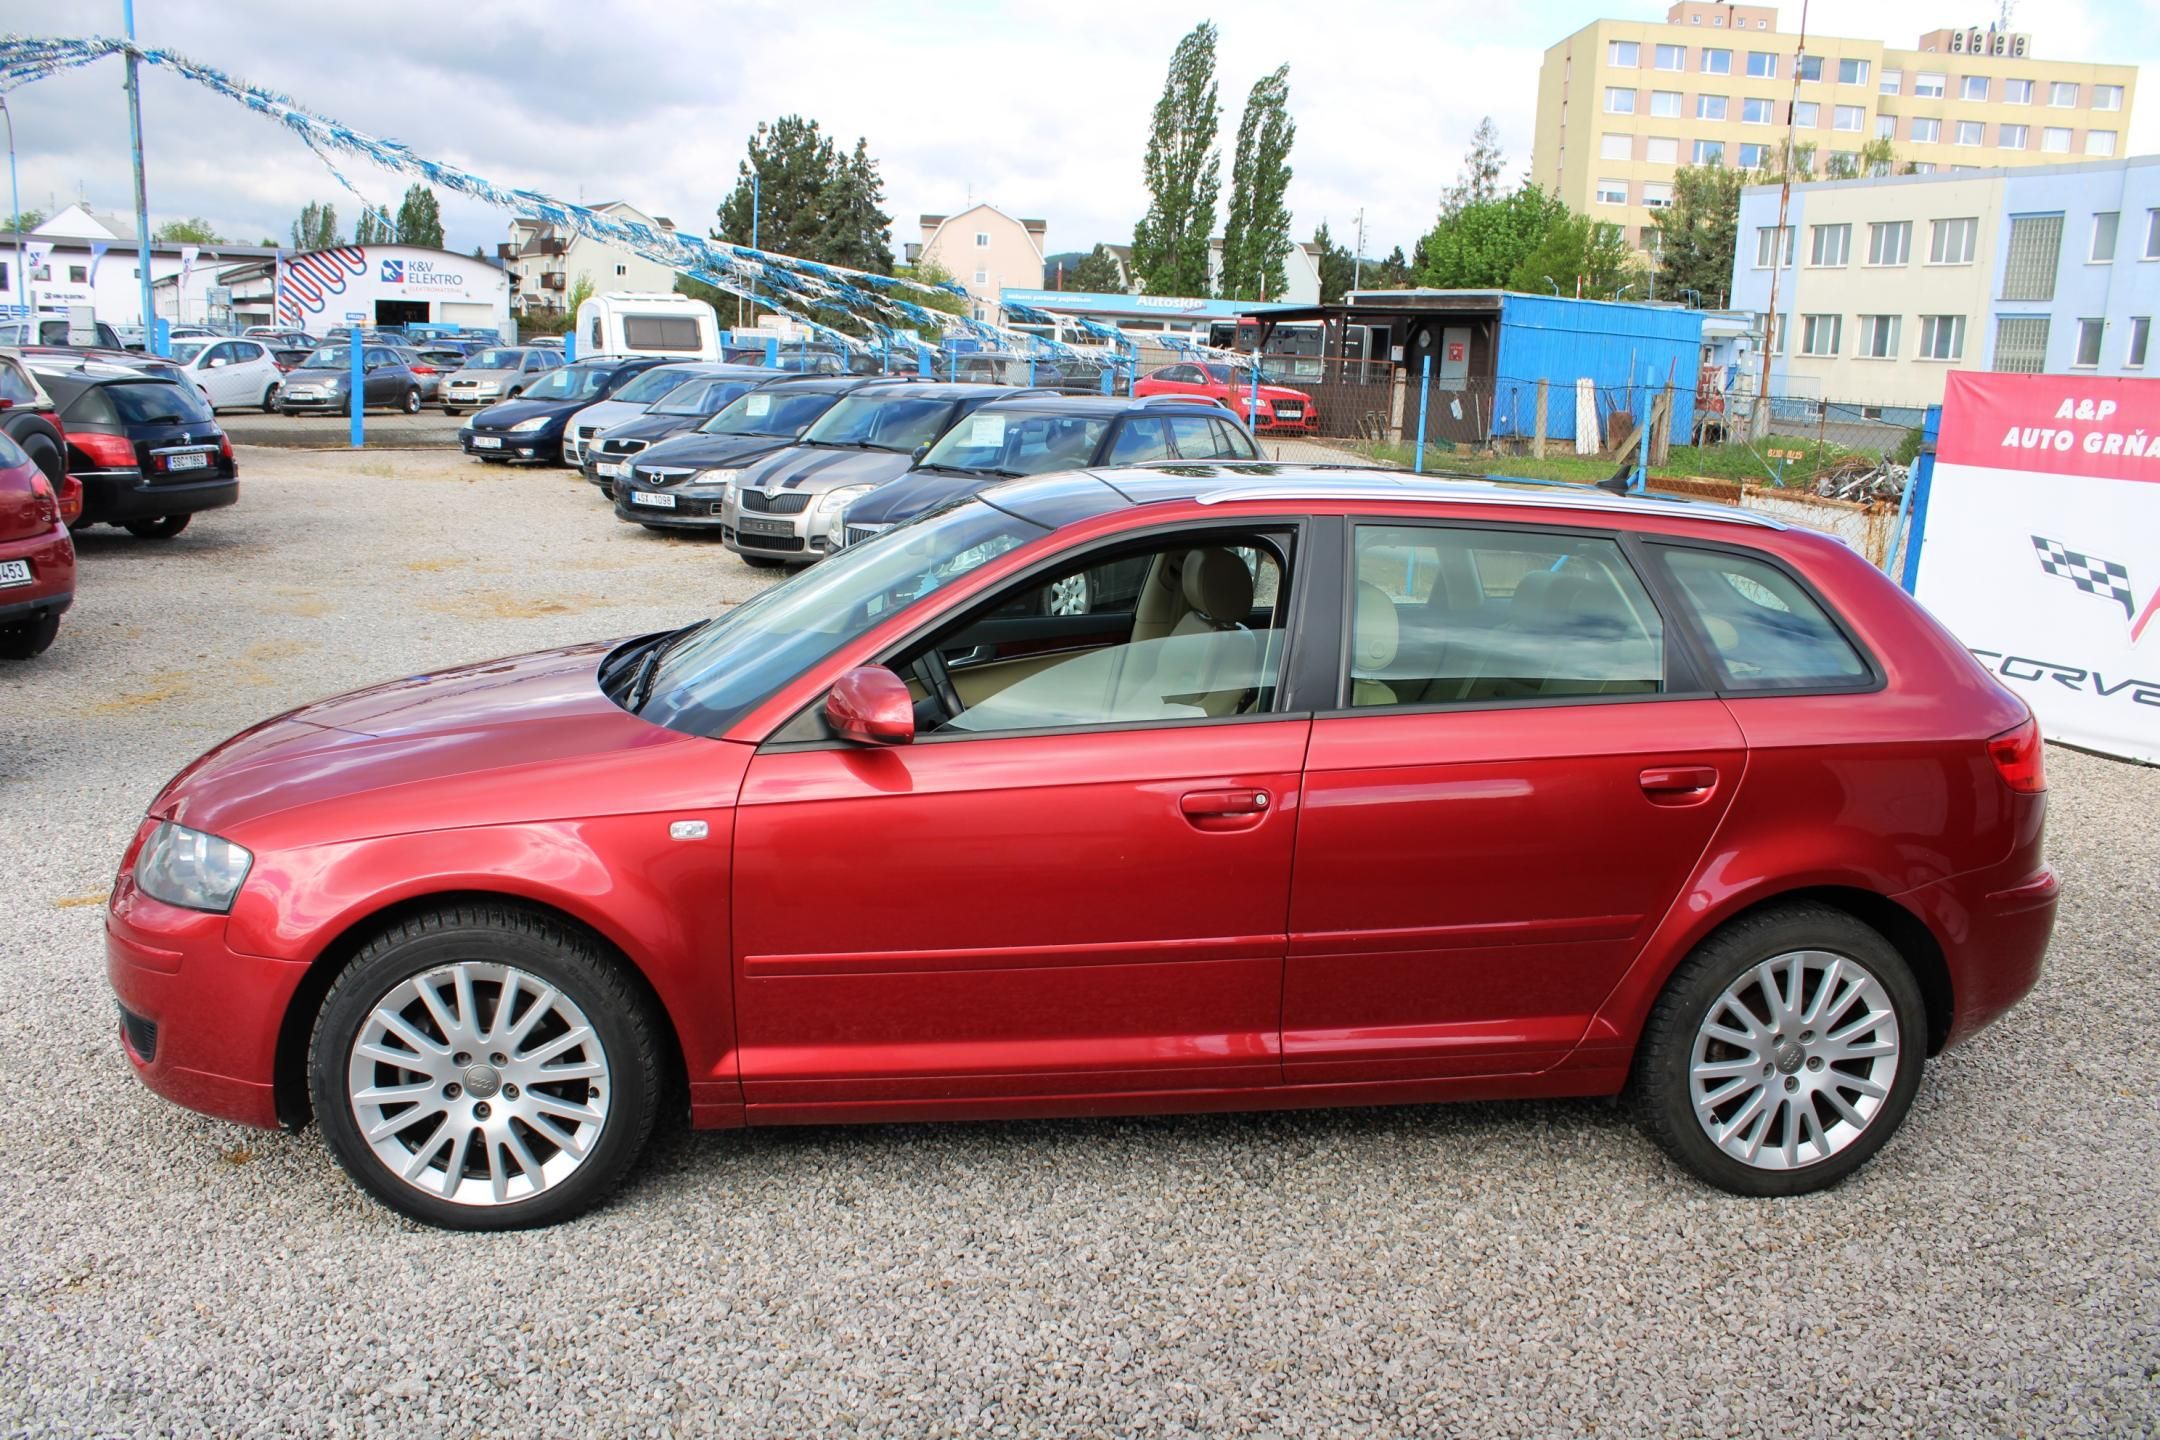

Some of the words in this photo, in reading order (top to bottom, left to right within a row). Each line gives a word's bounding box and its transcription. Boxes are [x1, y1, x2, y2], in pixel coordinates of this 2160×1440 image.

[408, 261, 434, 272] K&V
[408, 272, 463, 286] ELEKTRO
[2055, 398, 2118, 422] A&P
[2001, 427, 2075, 451] AUTO
[654, 495, 672, 506] 1098
[0, 563, 24, 580] 453
